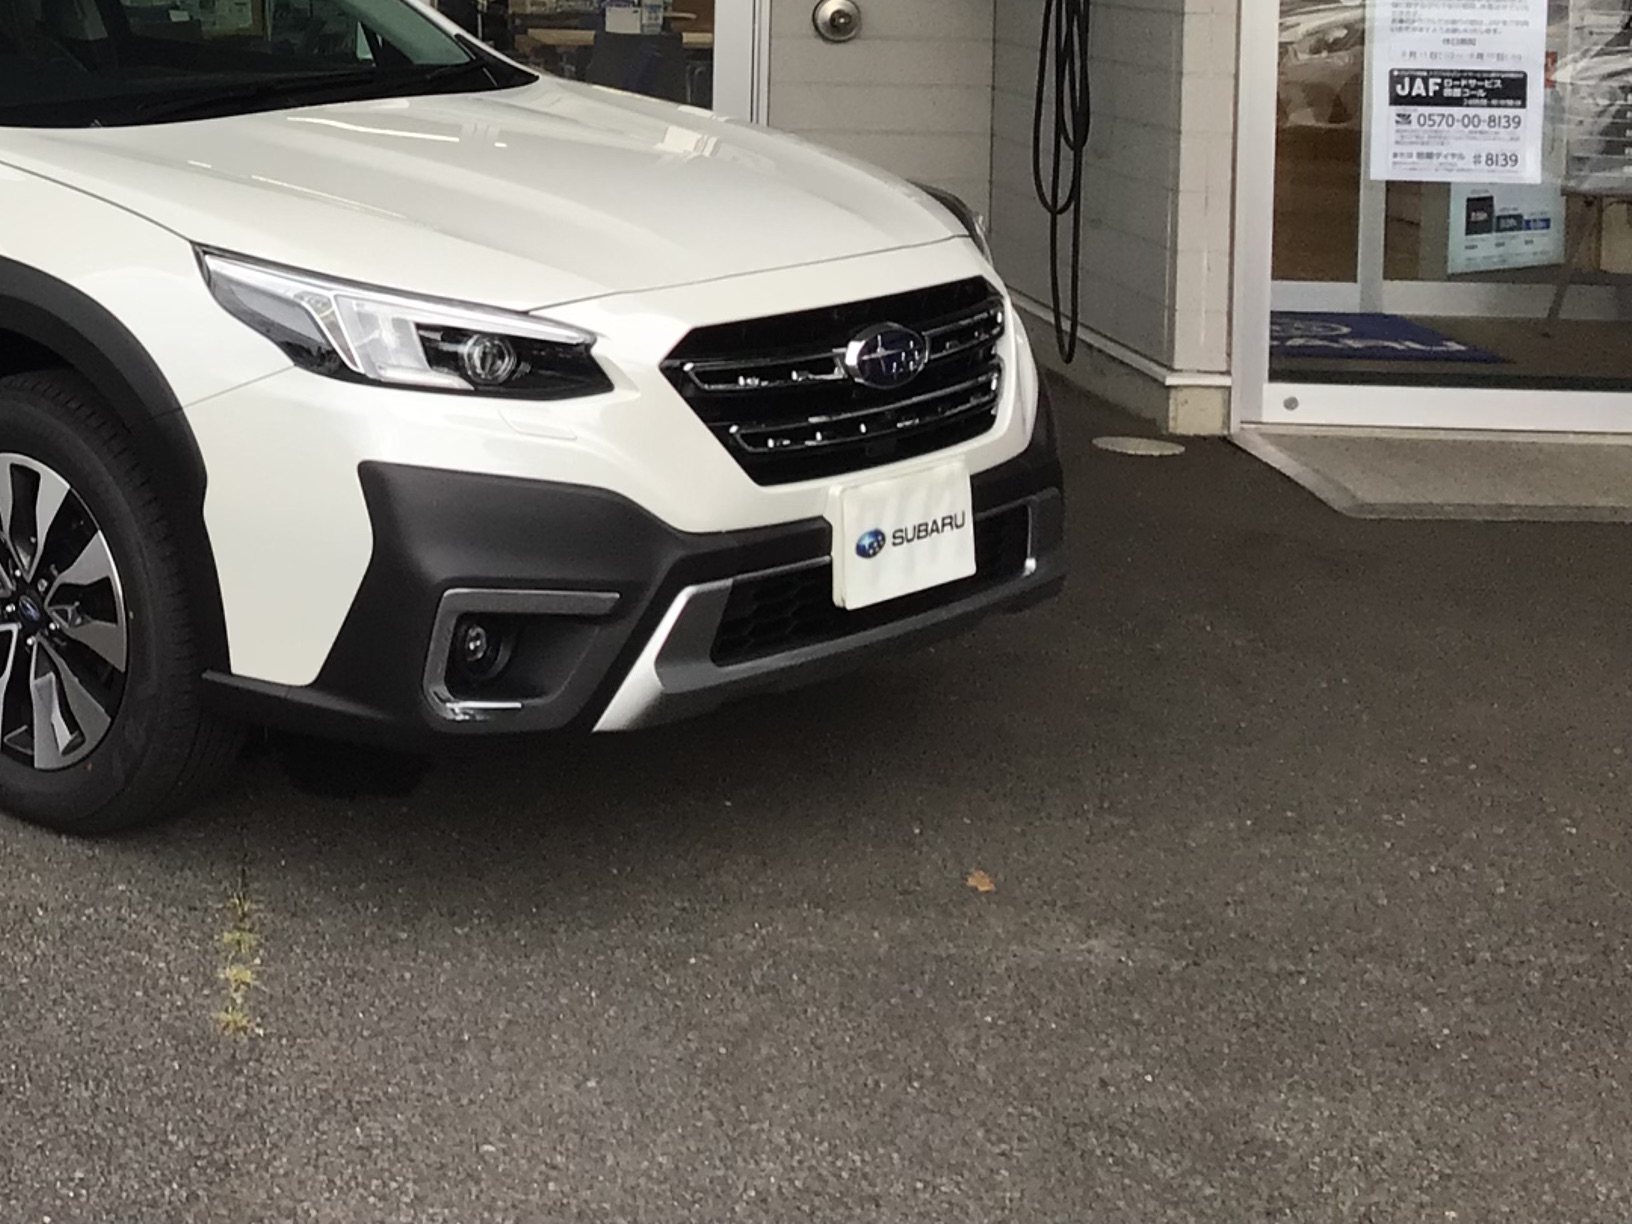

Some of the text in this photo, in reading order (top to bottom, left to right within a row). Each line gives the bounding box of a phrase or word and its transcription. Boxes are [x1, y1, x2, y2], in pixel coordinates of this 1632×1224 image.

[1395, 77, 1442, 98] JAF
[1416, 112, 1522, 130] 0570-00-8139
[891, 510, 966, 548] SUBARU
